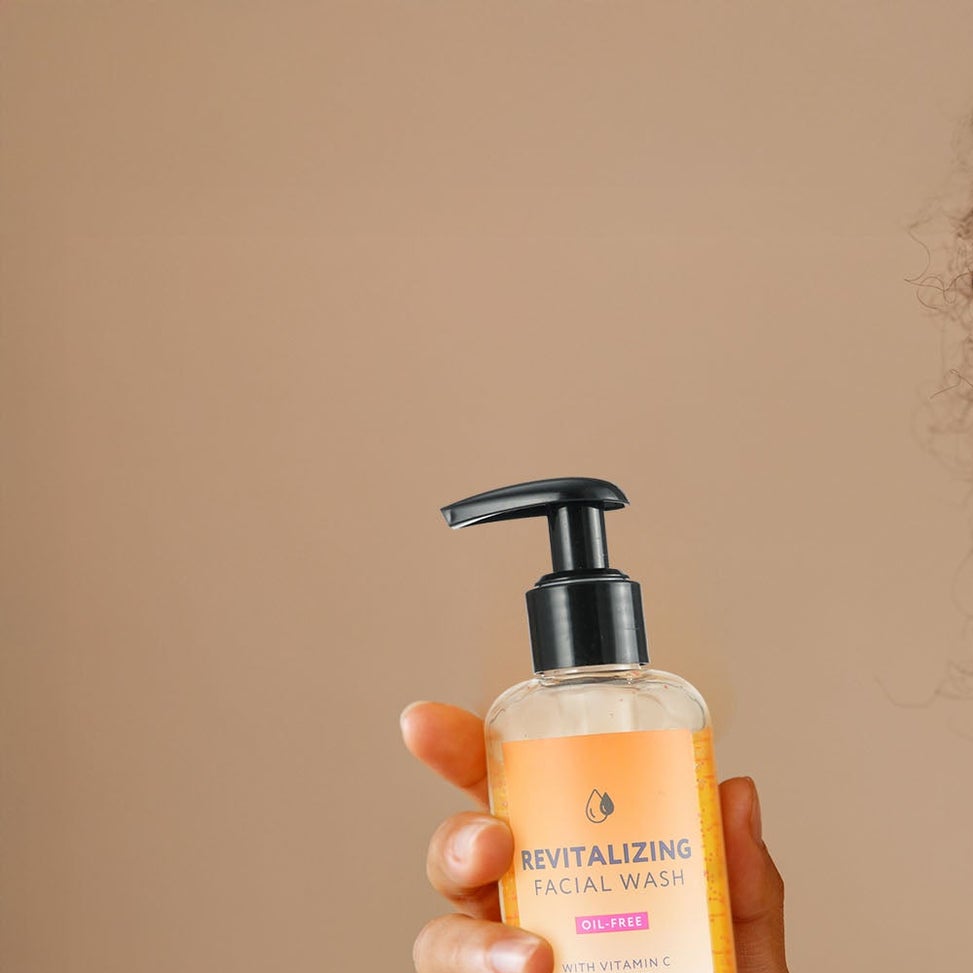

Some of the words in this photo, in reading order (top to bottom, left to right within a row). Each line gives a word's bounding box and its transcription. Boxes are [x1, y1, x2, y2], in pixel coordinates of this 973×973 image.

[521, 838, 692, 871] REVITALIZING
[534, 876, 612, 896] FACIAL
[620, 869, 685, 890] WASH
[581, 916, 643, 931] OIL-FREE
[562, 962, 596, 973] WITH
[600, 957, 658, 971] VITAMIN
[663, 956, 671, 967] C
